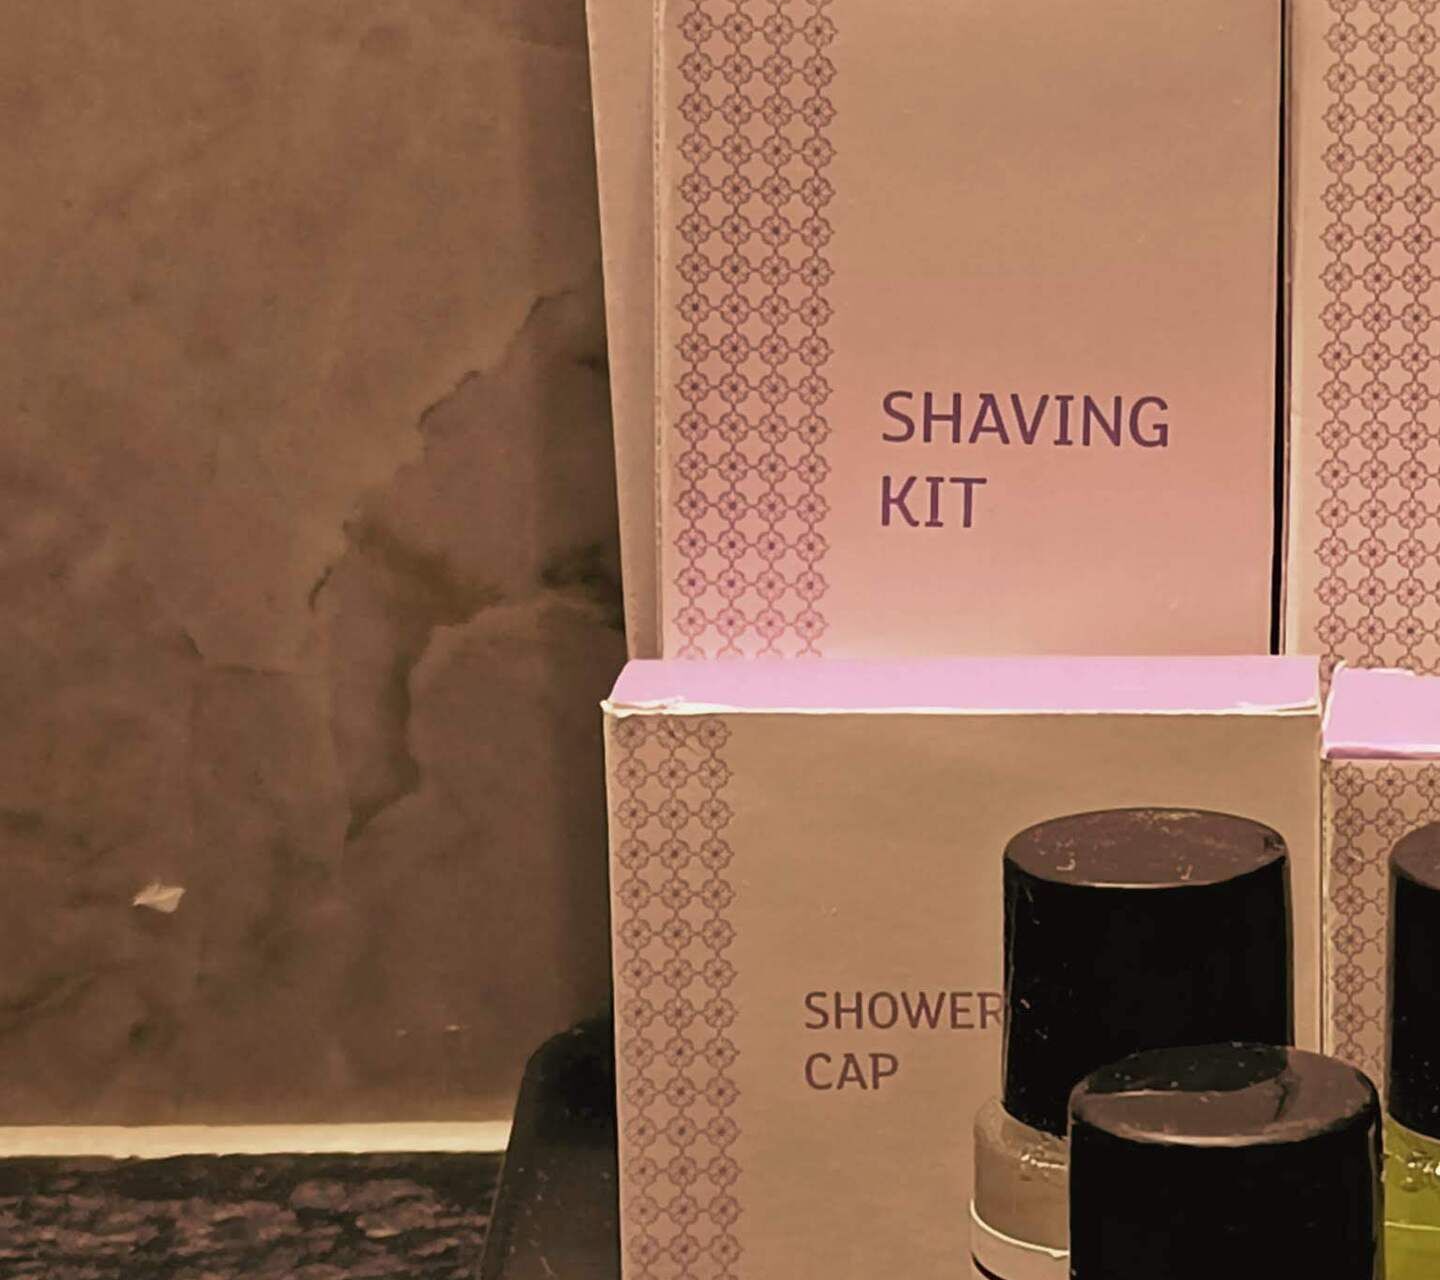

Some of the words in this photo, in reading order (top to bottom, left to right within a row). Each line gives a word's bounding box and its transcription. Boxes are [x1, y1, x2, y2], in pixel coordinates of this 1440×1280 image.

[880, 391, 1170, 448] SHAVING
[880, 475, 988, 529] KIT
[804, 991, 1003, 1030] SHOWER
[804, 1052, 899, 1090] CAP
